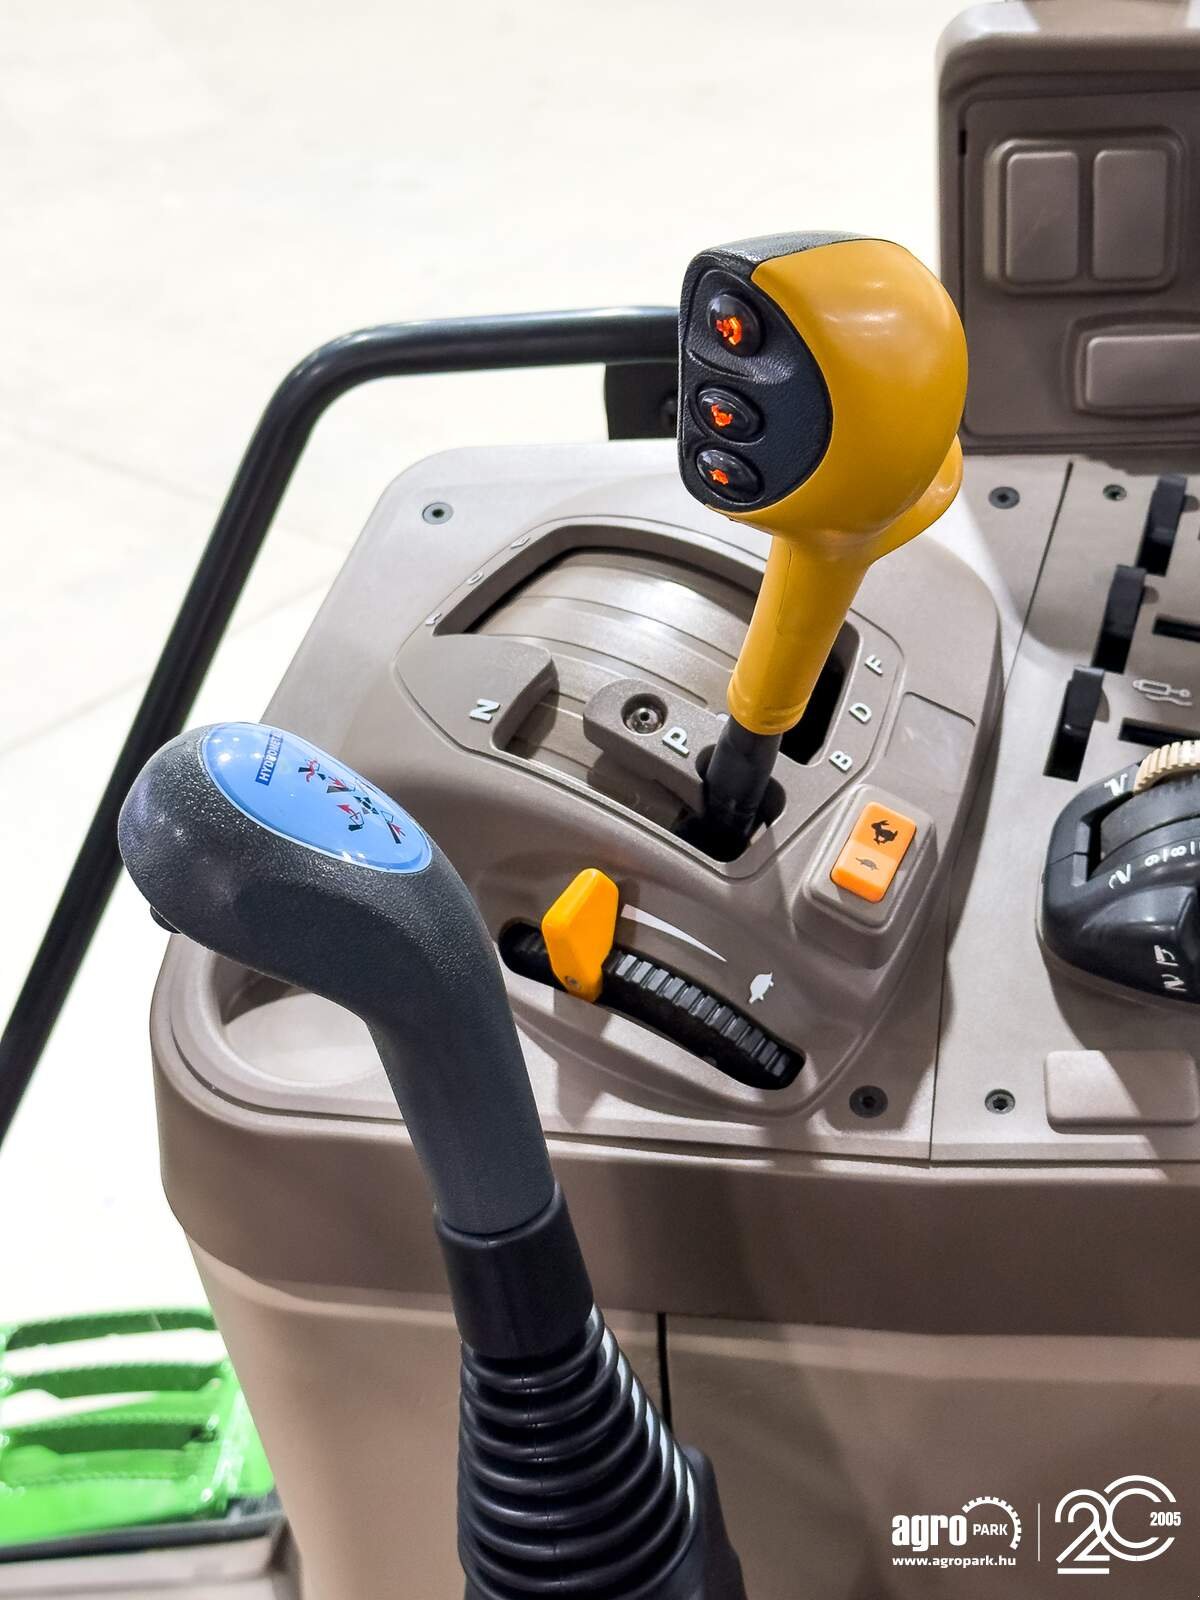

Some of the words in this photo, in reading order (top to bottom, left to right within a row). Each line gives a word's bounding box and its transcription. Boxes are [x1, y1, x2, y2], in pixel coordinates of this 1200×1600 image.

[864, 654, 883, 676] F
[469, 698, 500, 723] N
[849, 702, 872, 724] D
[662, 726, 690, 756] P
[829, 750, 853, 772] B
